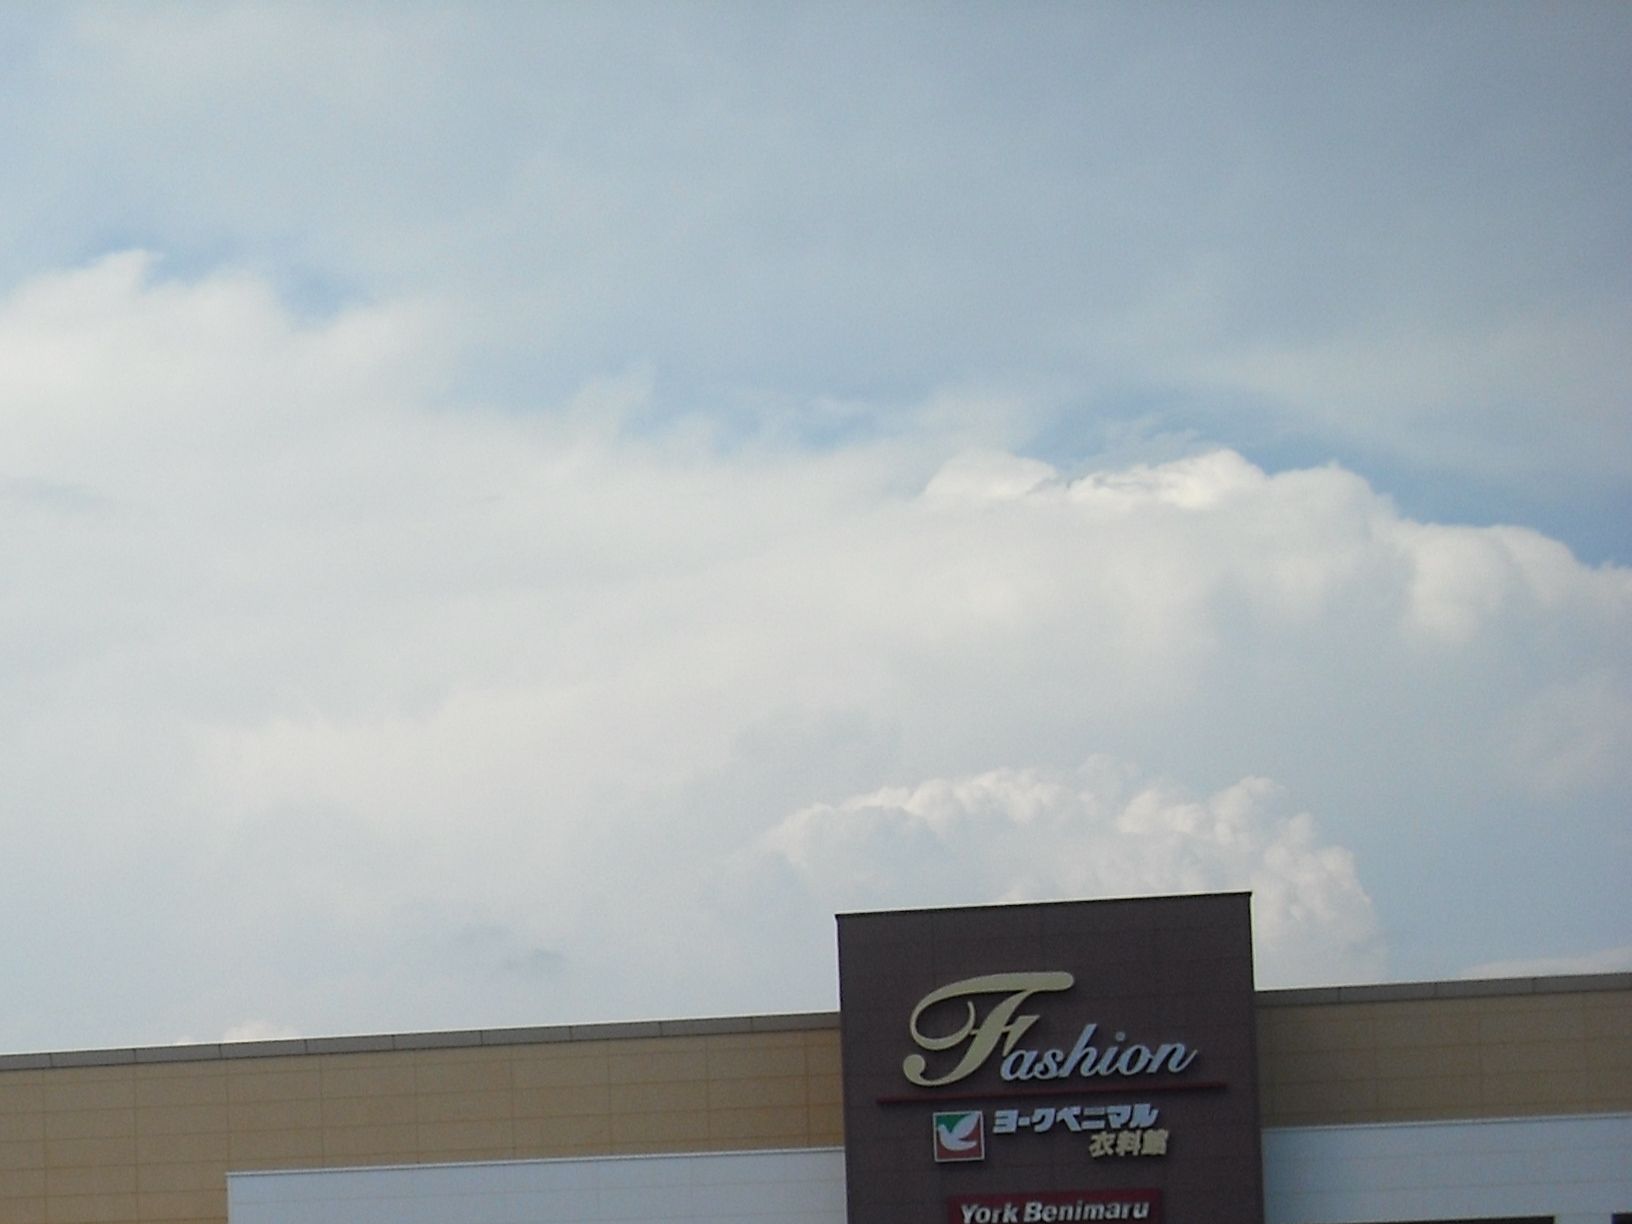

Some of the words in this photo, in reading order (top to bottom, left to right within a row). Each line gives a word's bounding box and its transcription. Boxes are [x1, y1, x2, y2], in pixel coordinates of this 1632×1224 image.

[902, 971, 1198, 1088] Fashion
[992, 1103, 1160, 1134] ヨークベニマル
[1089, 1129, 1169, 1159] 衣料館
[1023, 1200, 1150, 1223] Benimaru
